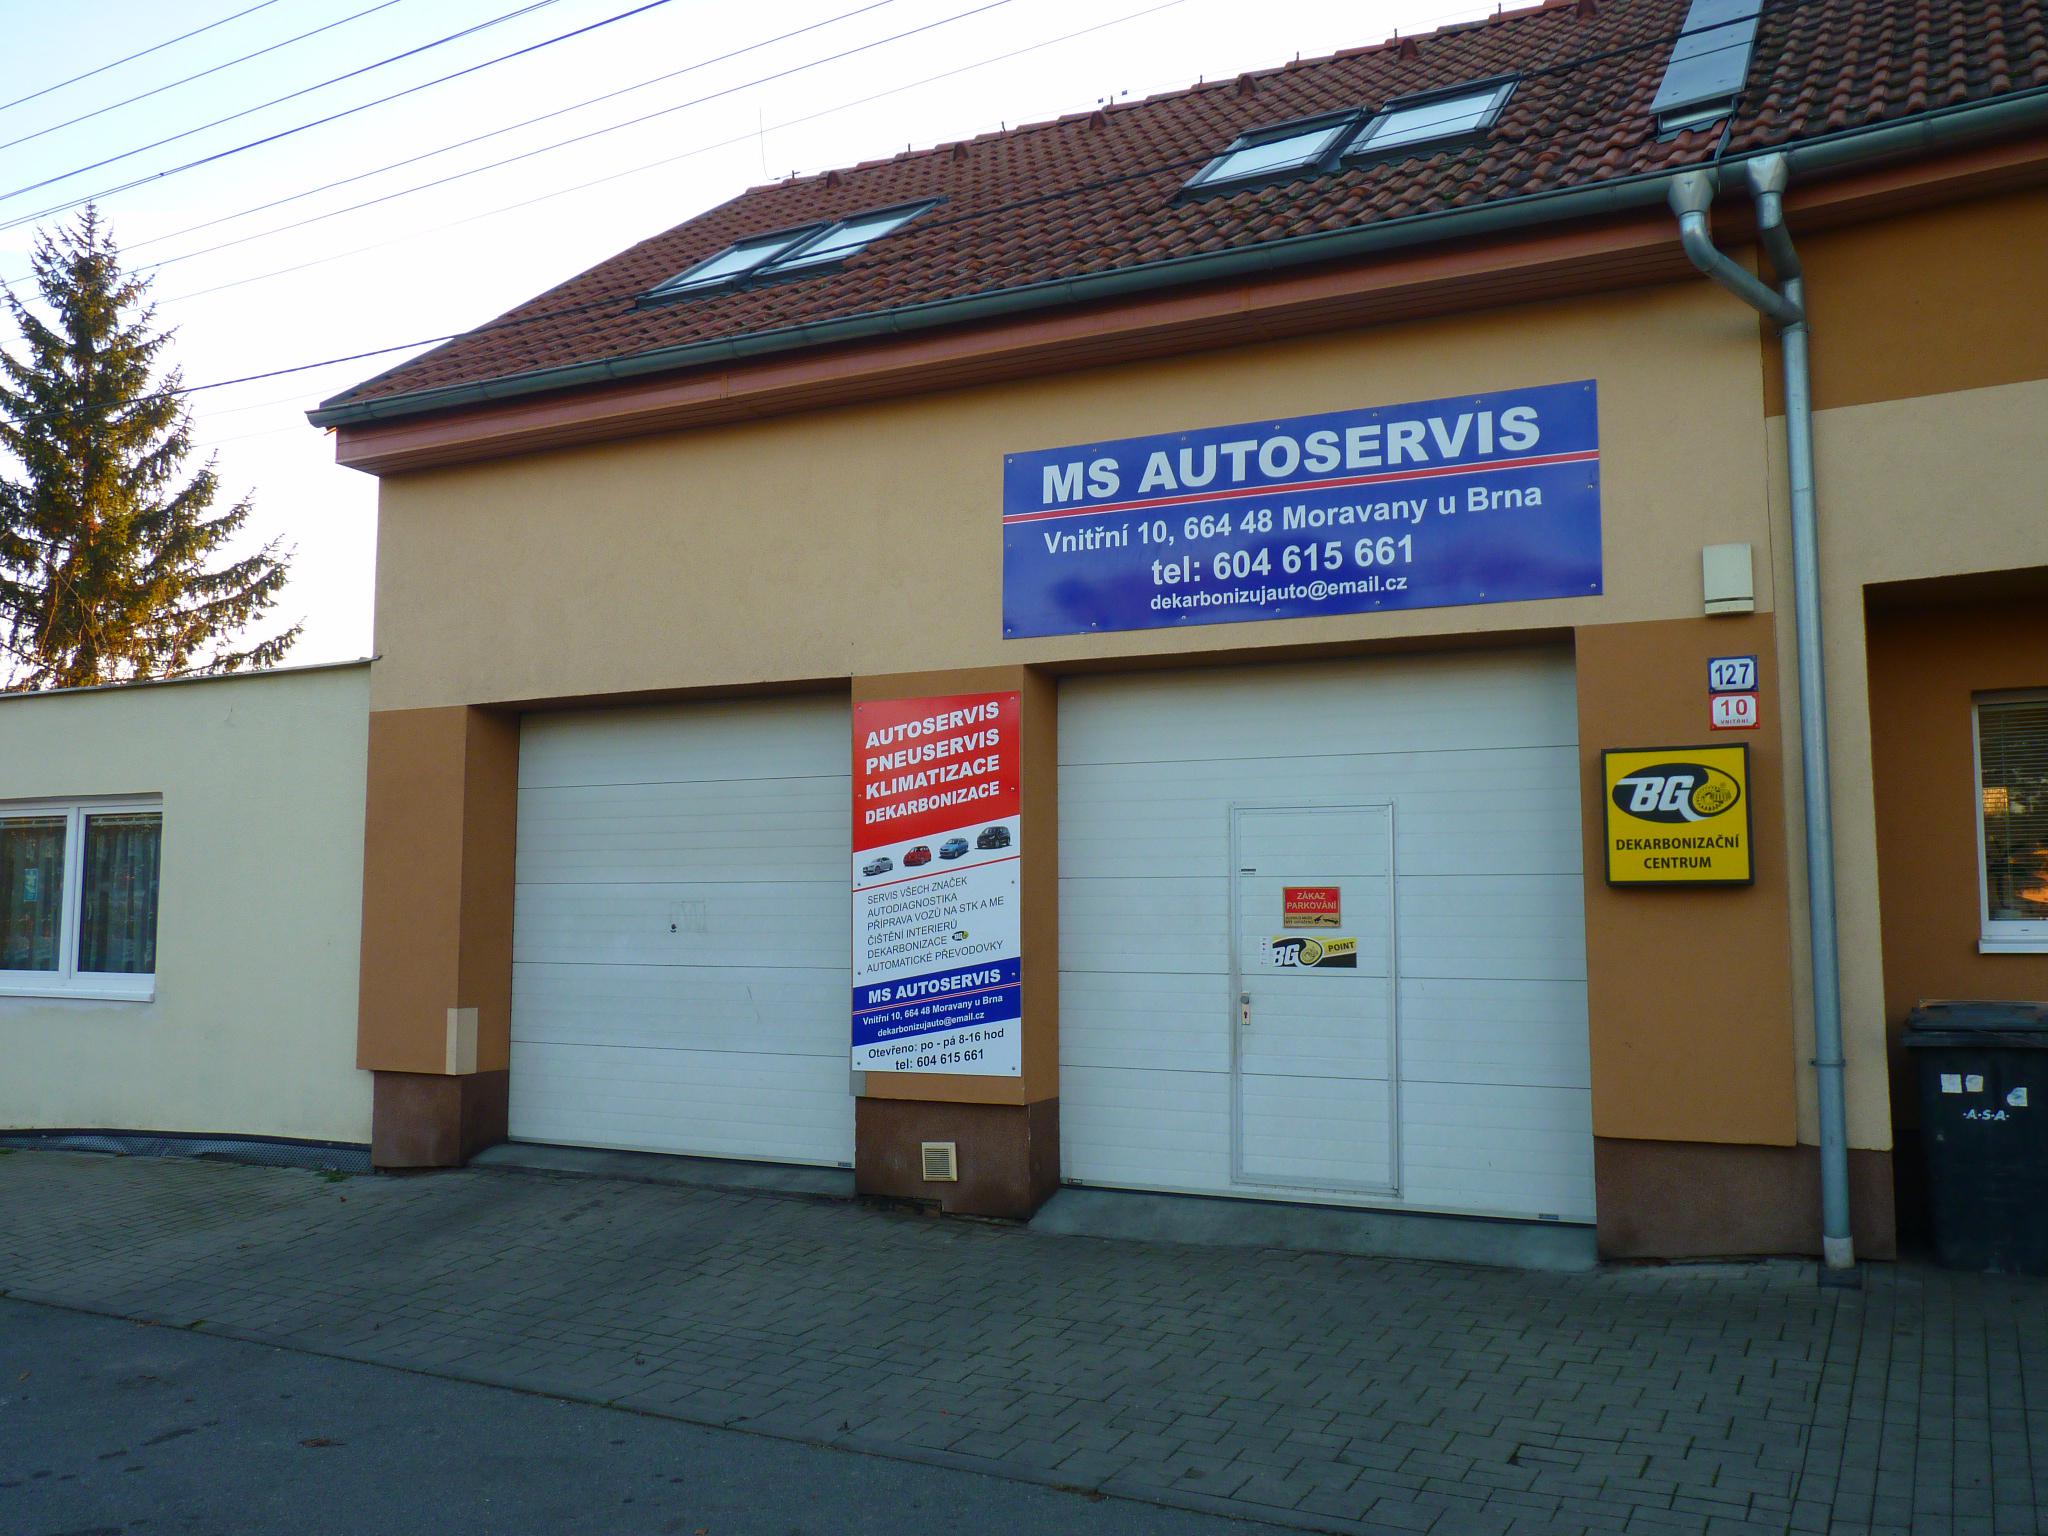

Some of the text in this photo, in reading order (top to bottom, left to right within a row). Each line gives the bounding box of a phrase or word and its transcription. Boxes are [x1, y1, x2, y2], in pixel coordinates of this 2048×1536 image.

[1043, 406, 1540, 504] MS AUTOSERVIS
[1044, 486, 1542, 554] Vnitřní 10, 664 48 Moravany u Brna
[1151, 534, 1413, 586] tel: 604 615 661
[1150, 575, 1407, 610] dekarbonizujauto@email.cz
[1715, 663, 1750, 685] 127
[1721, 699, 1748, 716] 10
[865, 701, 999, 749] AUTOSERVIS
[866, 728, 1000, 775] PNEUSERVIS
[866, 754, 1000, 800] KLIMATIZACE
[865, 780, 1000, 824] DEKARBONIZACE
[1615, 775, 1696, 815] BG
[1616, 834, 1739, 851] DEKARBONIZAČNÍ
[1643, 856, 1712, 869] CENTRUM
[867, 876, 968, 905] SERVIS VŠECH ZNAČEK
[867, 892, 958, 918] AUTODIAGNOSTIKA
[1287, 900, 1337, 910] PARKOVÁNÍ
[1296, 890, 1326, 900] ZÁKAZ
[867, 896, 1005, 931] PŘÍPRAVA VOZŮ NA STK A ME
[867, 919, 958, 946] ČIŠTĚNÍ INTERIERŮ
[867, 935, 947, 959] DEKARBONIZACE
[1328, 942, 1355, 952] POINT
[867, 940, 1004, 973] AUTOMATICKÉ PŘEVODOVKY
[868, 968, 1001, 1004] MS AUTOSERVIS
[862, 995, 1003, 1026] Vnitřní 10, 664 48 Moravany u Brna
[877, 1011, 985, 1037] dekarbonizujauto@email.cz
[868, 1043, 918, 1059] Otevřeno:
[920, 1041, 934, 1053] po
[943, 1035, 956, 1049] pá
[958, 1031, 981, 1044] 8-16
[984, 1027, 1004, 1040] hod
[895, 1048, 984, 1071] tel: 604 615 661
